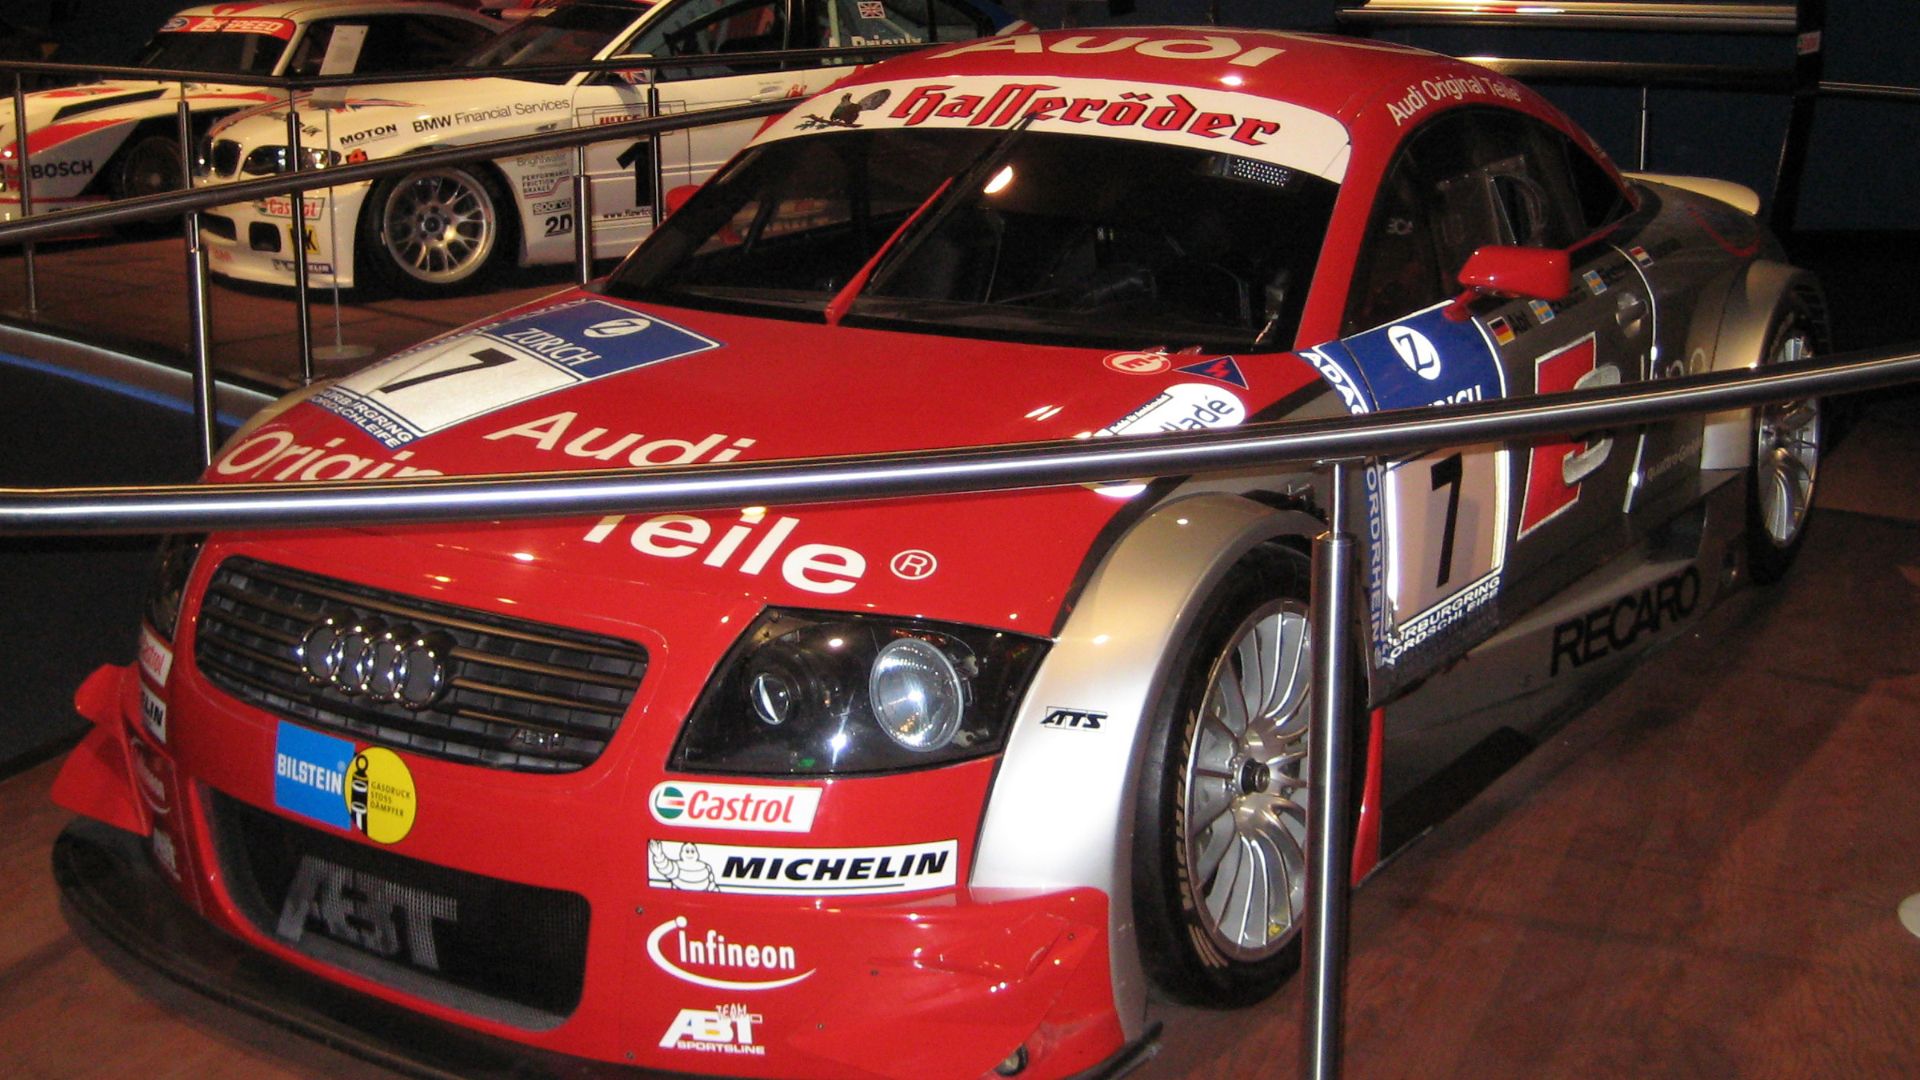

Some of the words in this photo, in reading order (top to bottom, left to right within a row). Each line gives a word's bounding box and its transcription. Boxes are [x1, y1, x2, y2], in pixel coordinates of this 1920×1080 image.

[412, 115, 451, 133] BMW
[455, 106, 512, 125] Financial
[514, 99, 570, 116] Services
[1386, 85, 1428, 126] Audi
[1421, 74, 1486, 101] Original
[1480, 77, 1521, 102] Teile
[340, 124, 398, 145] MOTON
[31, 161, 93, 179] BOSCH
[616, 141, 652, 207] 1
[269, 198, 317, 216] Casol
[379, 348, 516, 393] 7
[483, 411, 757, 467] Audi
[1433, 452, 1463, 588] 7
[1366, 465, 1382, 642] ORDRHEIN
[1550, 567, 1699, 677] RECARO
[1041, 710, 1108, 729] ATS
[277, 753, 342, 796] BILSTEIN
[371, 781, 411, 799] GASDRUCK
[688, 790, 794, 824] Castrol
[722, 850, 949, 881] MICHELIN
[716, 1002, 747, 1018] TEAM
[659, 1009, 763, 1048] ABT
[677, 1040, 766, 1055] SPORTSLINE
